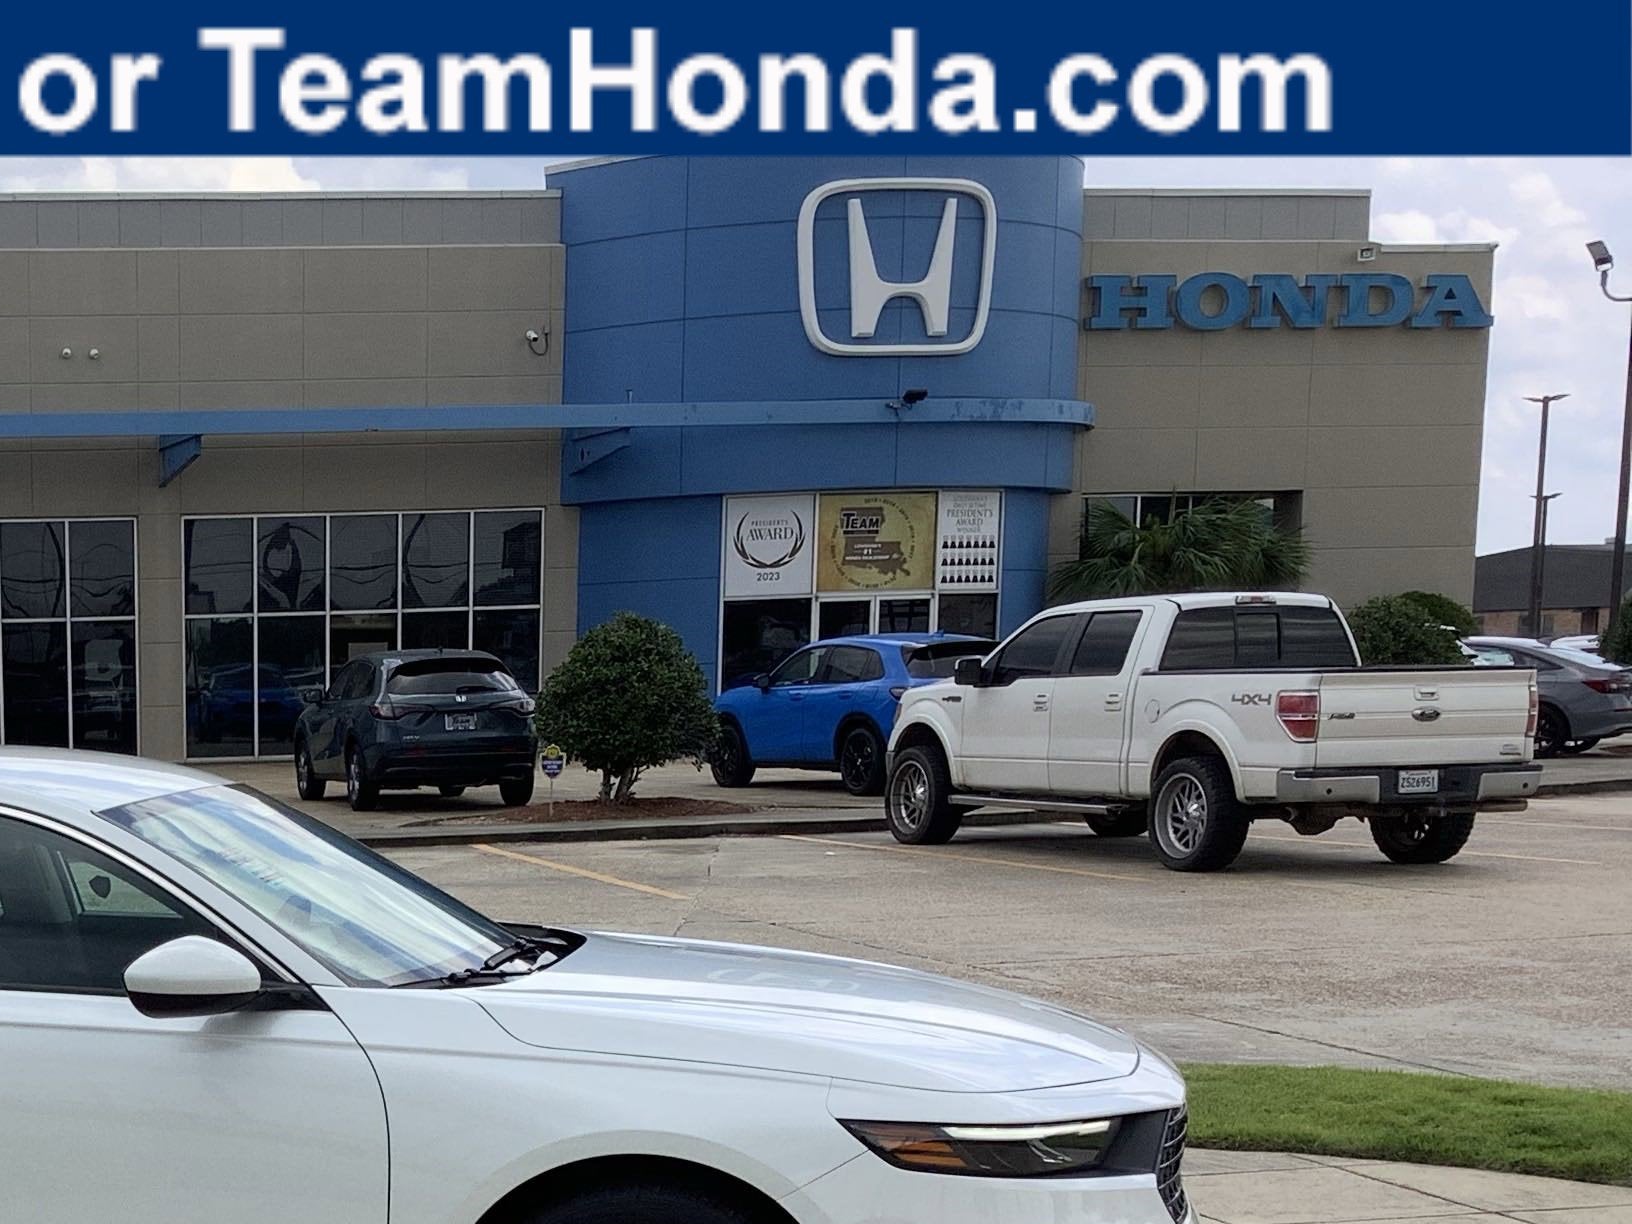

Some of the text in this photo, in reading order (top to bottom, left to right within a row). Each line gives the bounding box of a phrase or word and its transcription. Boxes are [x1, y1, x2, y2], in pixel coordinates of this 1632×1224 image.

[1084, 271, 1494, 331] HONDA
[956, 518, 984, 527] AWARD
[746, 527, 794, 541] AWARD
[756, 572, 781, 582] 2023
